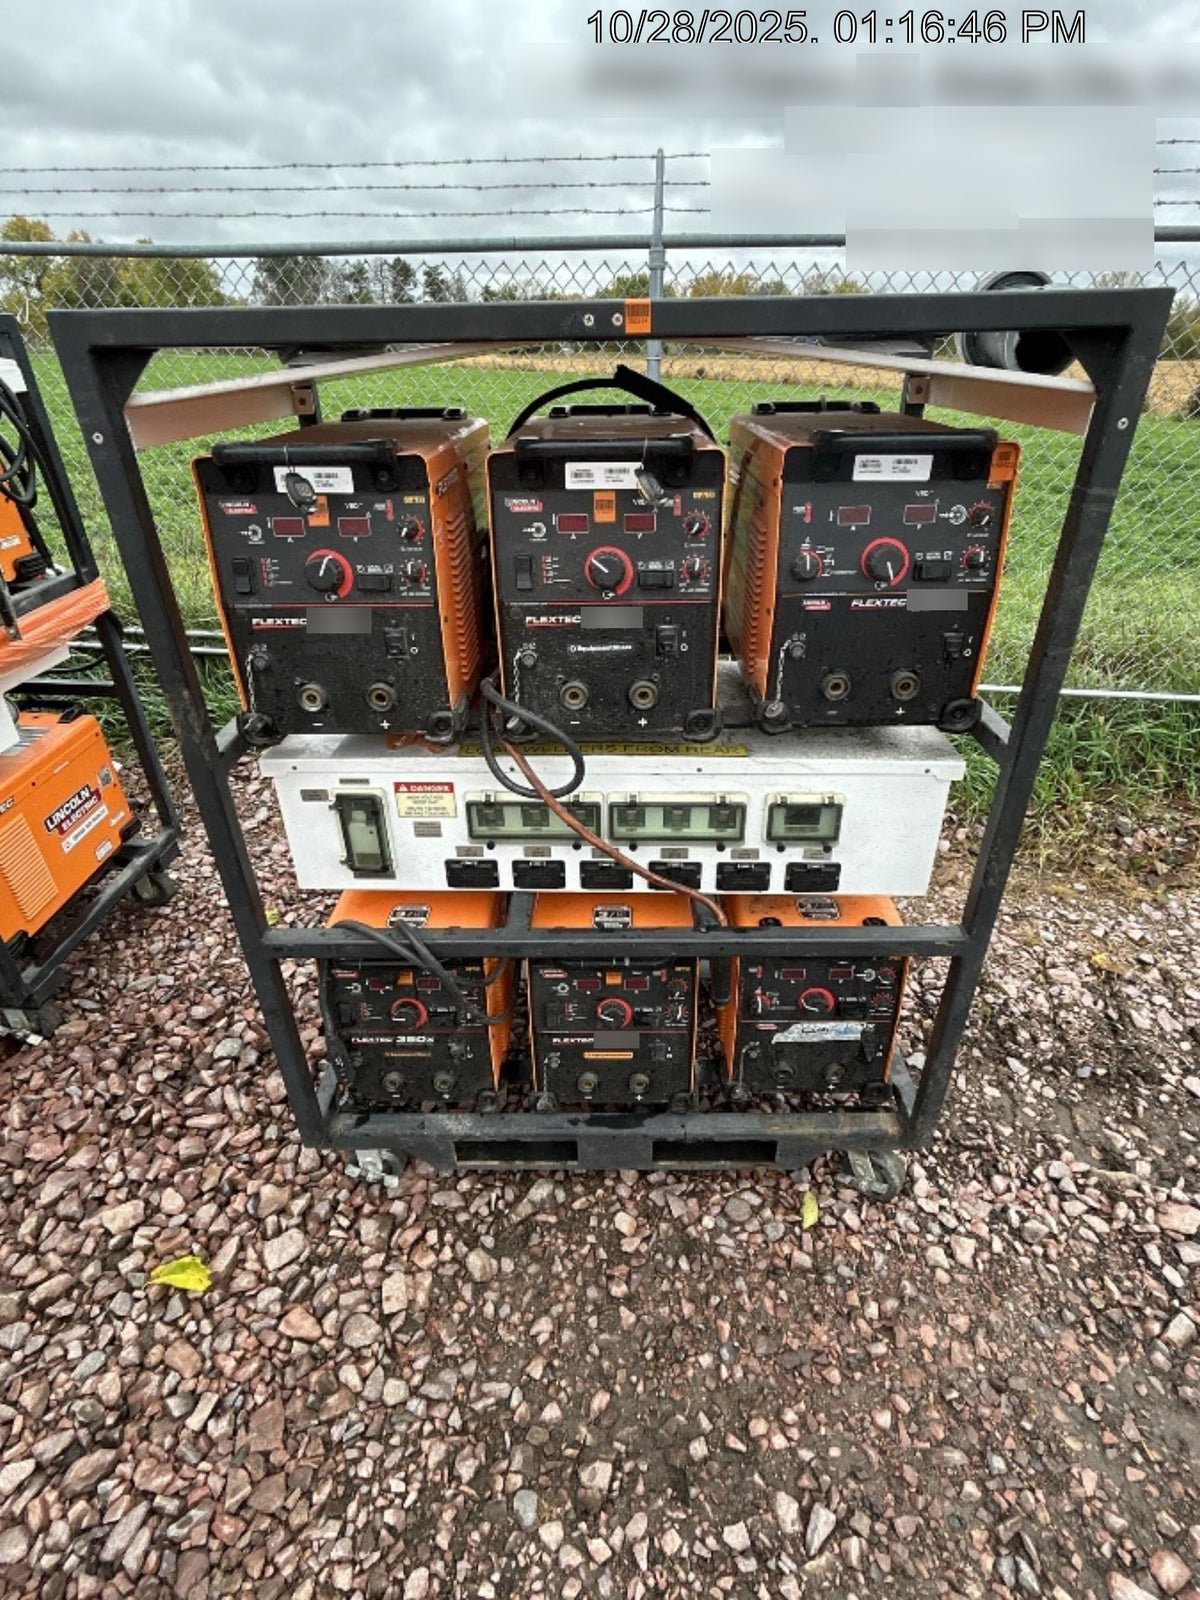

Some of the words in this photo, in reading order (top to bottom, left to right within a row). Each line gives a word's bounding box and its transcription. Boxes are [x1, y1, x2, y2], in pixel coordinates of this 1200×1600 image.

[850, 599, 908, 608] FLEXTEC
[525, 615, 582, 624] FLEXTEC
[623, 743, 681, 754] FROM
[45, 786, 92, 831] LINCOLN
